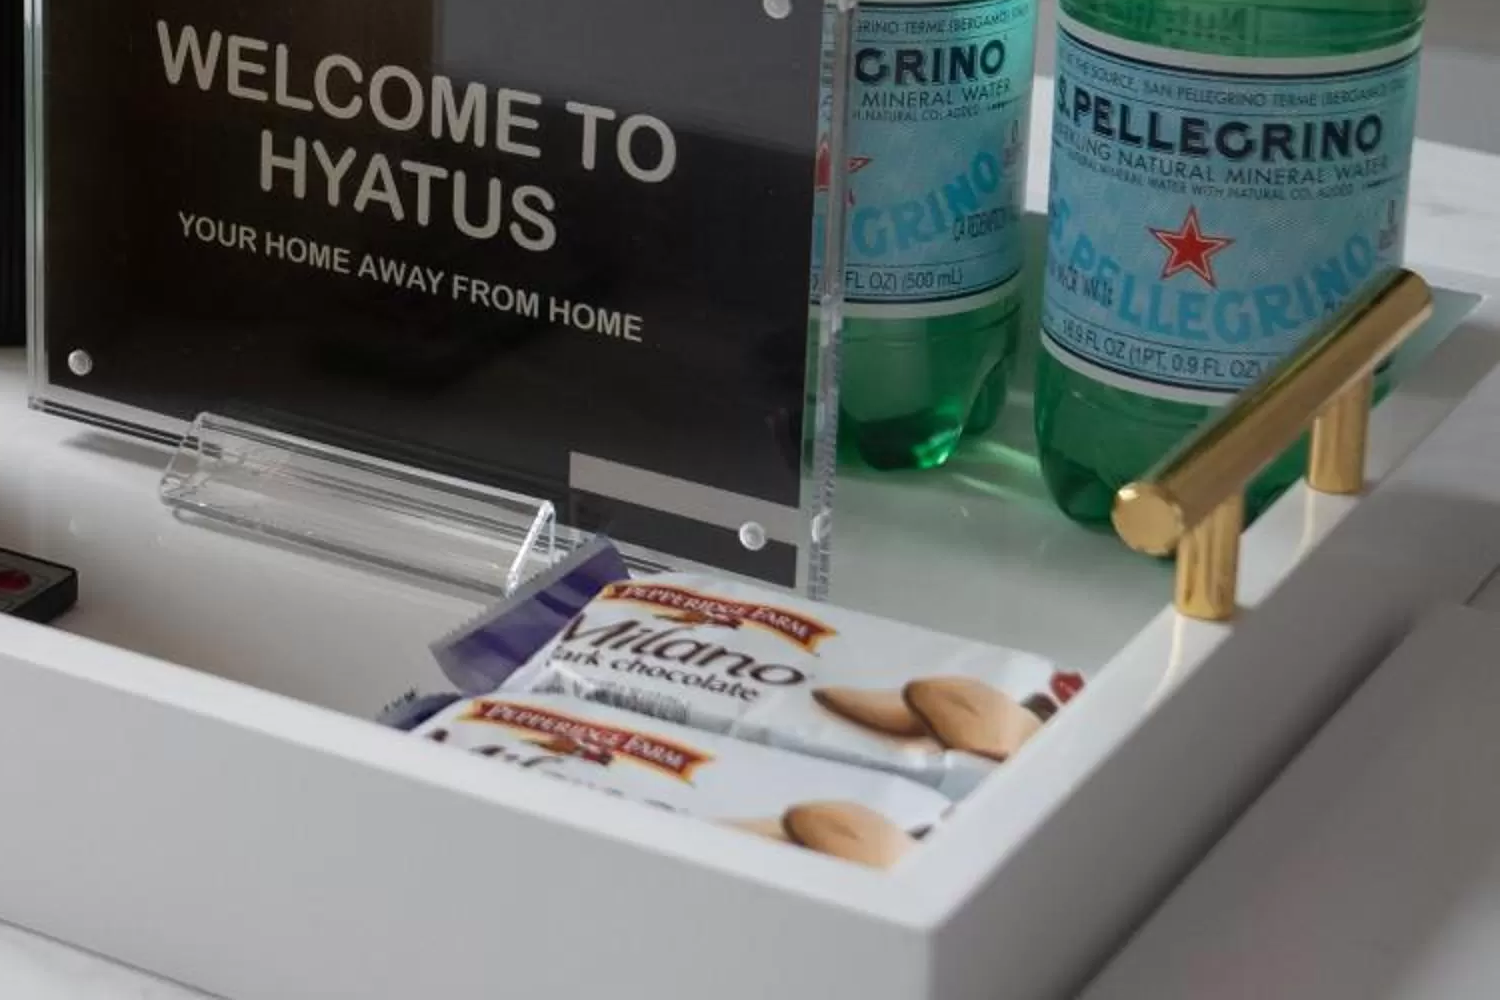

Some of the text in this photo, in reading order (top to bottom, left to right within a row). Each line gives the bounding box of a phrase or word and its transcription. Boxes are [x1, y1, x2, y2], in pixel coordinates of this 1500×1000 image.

[156, 19, 677, 183] WELCOME TO
[861, 78, 1011, 110] MINERAL WATER
[1057, 74, 1382, 162] S.PELLEGRINO
[259, 129, 558, 252] HYATUS
[1118, 150, 1216, 184] NATURAL
[1225, 165, 1324, 186] MINERAL
[178, 210, 644, 343] YOUR HOME AWAY FROM HOME
[1103, 336, 1126, 359] OZ
[1203, 358, 1225, 377] FL
[610, 656, 759, 700] chocolate
